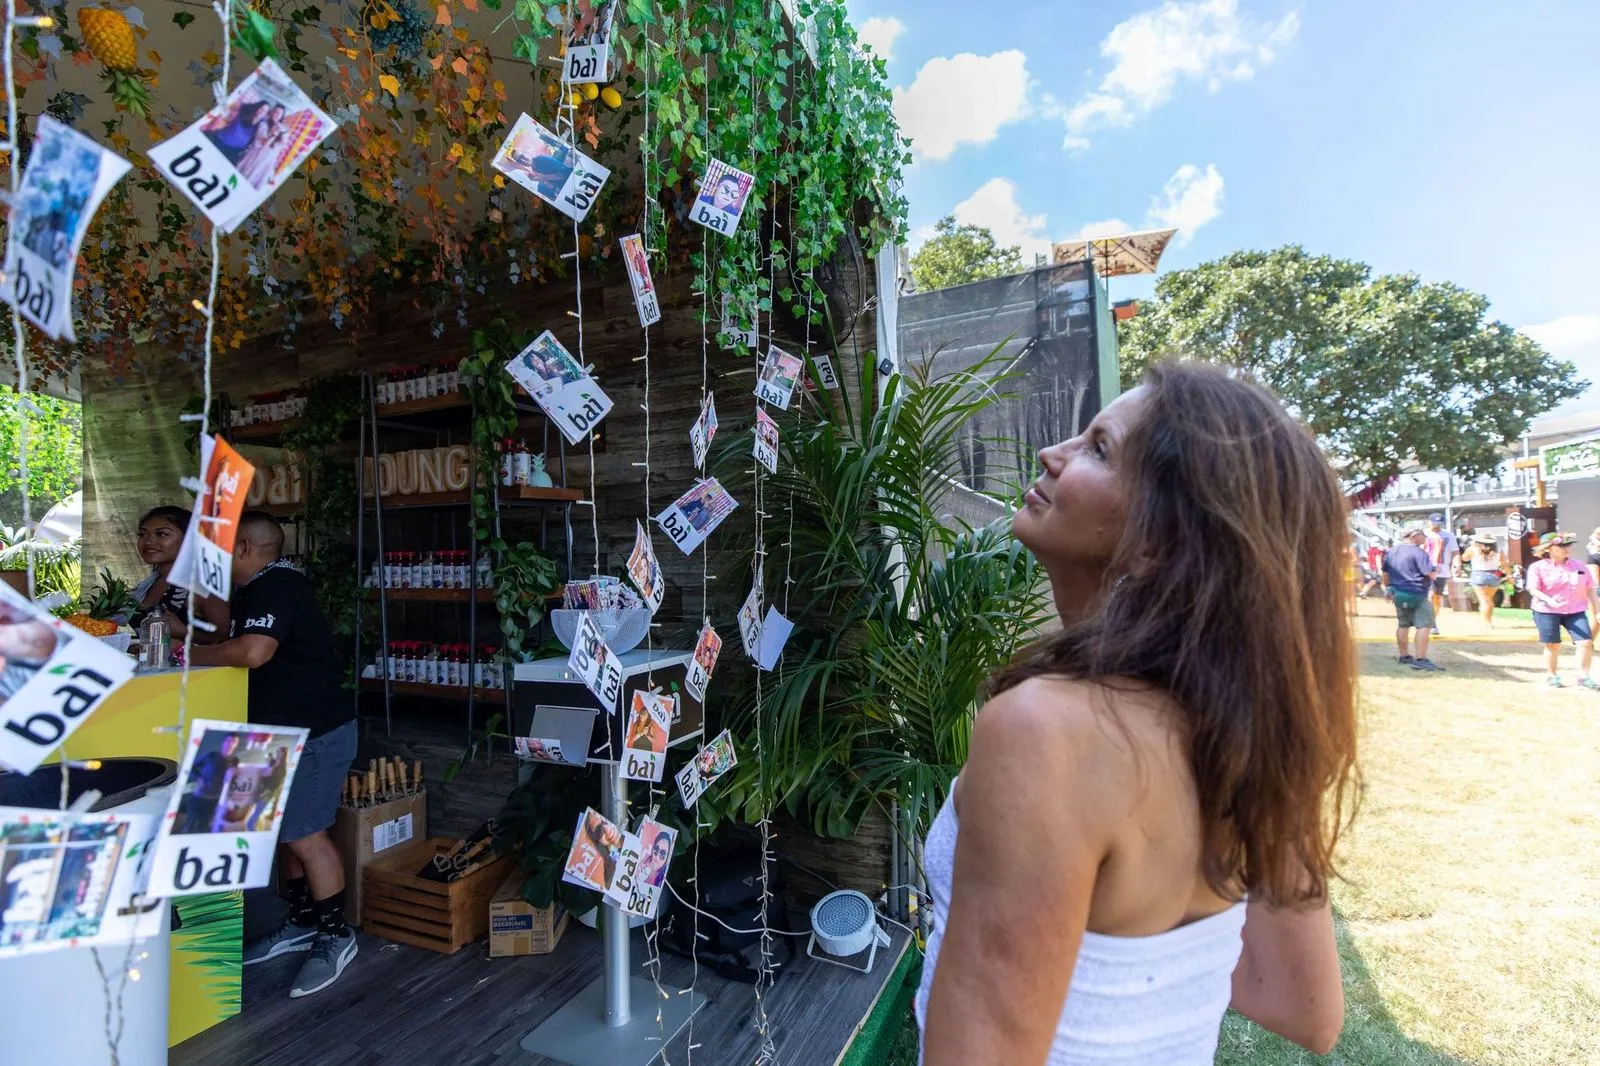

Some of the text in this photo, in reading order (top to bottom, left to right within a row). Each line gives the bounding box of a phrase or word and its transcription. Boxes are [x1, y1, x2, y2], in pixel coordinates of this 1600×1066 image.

[569, 49, 597, 79] bai
[169, 146, 238, 209] bai
[564, 170, 603, 210] bai
[699, 206, 729, 232] bai
[15, 257, 54, 325] bai
[642, 299, 657, 322] bai
[821, 362, 834, 384] bai
[761, 385, 783, 406] bai
[568, 395, 605, 433] bai
[758, 448, 772, 468] bai
[663, 513, 691, 544] bai
[202, 547, 223, 594] bai
[603, 666, 620, 704] bai
[5, 666, 114, 747] bai
[652, 703, 666, 723] bai
[627, 753, 656, 779] bai
[681, 768, 696, 801] bai
[173, 841, 250, 890] bai
[616, 850, 639, 892] bai
[627, 886, 652, 915] bai
